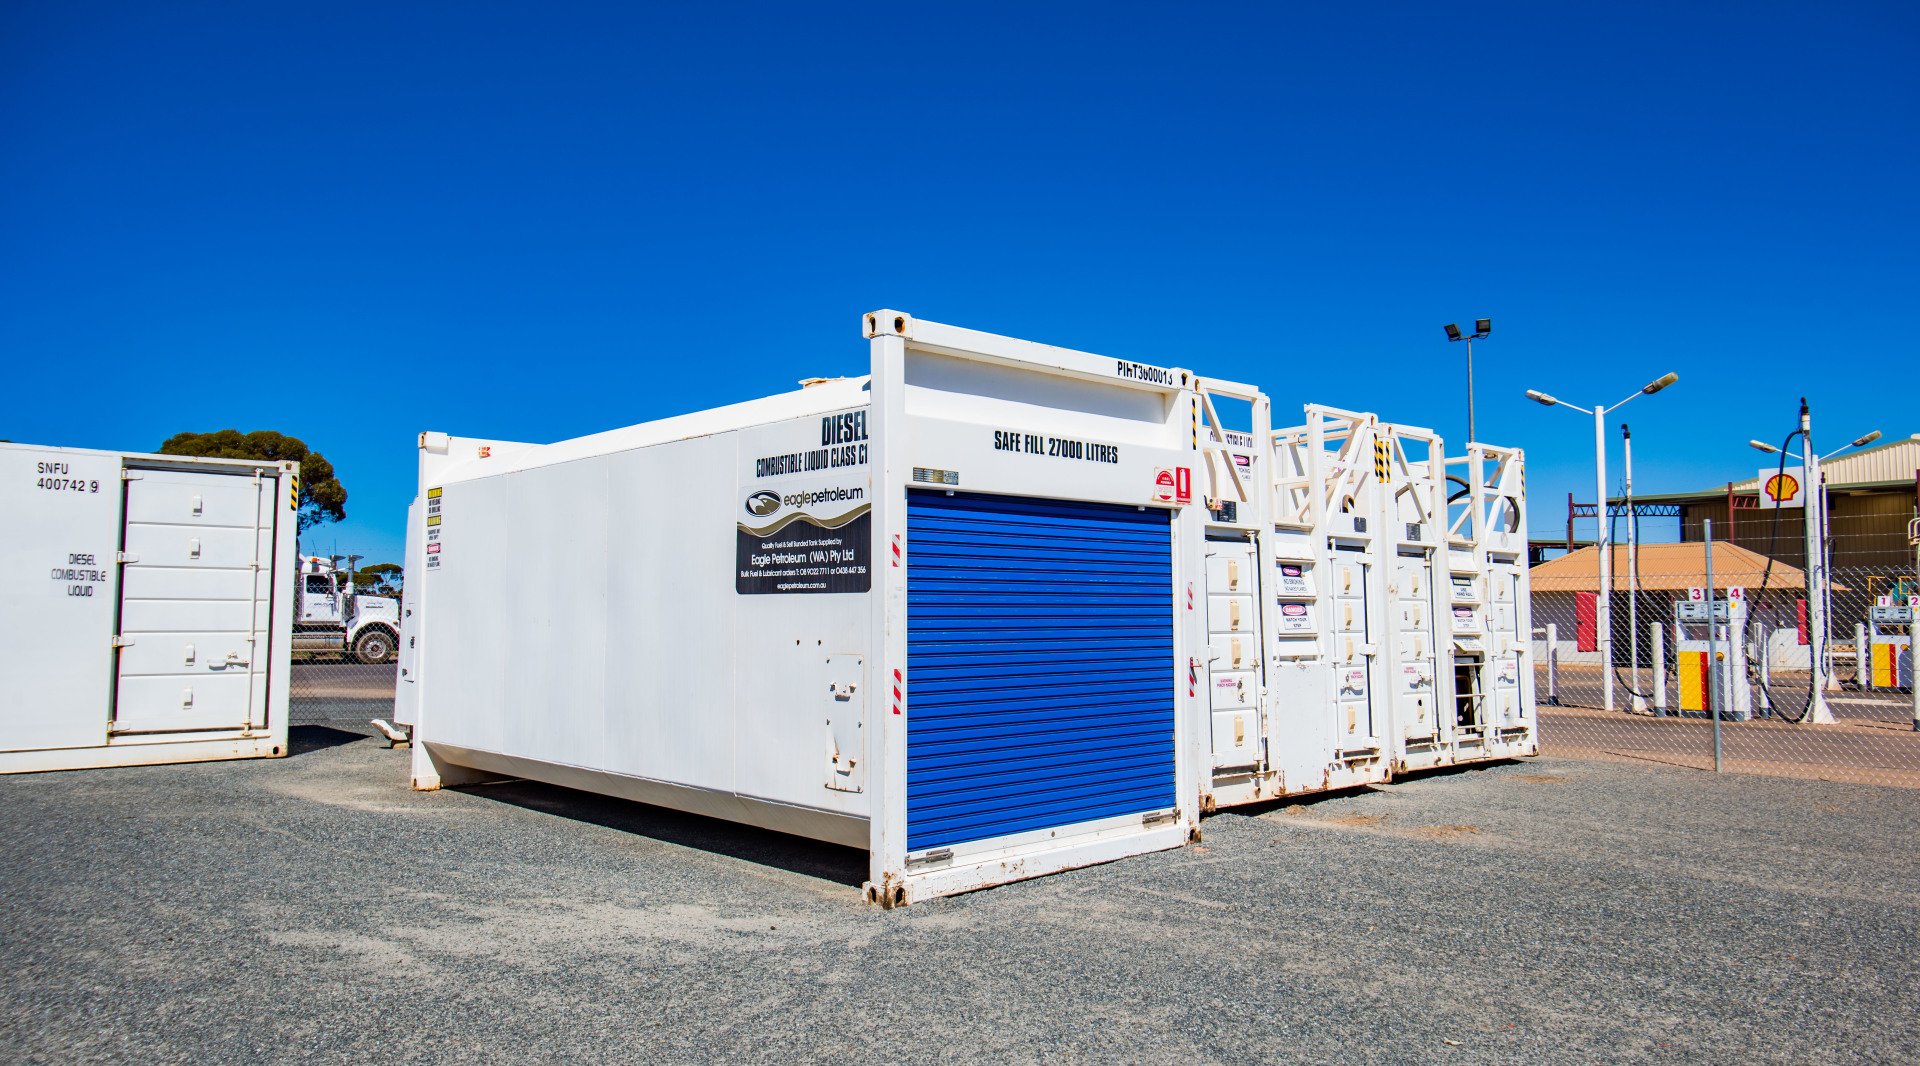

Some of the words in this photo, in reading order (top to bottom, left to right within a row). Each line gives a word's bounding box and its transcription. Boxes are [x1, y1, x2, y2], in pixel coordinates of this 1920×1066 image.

[821, 410, 868, 446] DIESEL
[994, 430, 1021, 453] SAFE
[1024, 434, 1045, 455] FILL
[1048, 437, 1082, 460] 27000
[1085, 442, 1118, 464] LITRES
[756, 452, 802, 478] COMBUSTIBLE
[804, 448, 829, 471] LIQUID
[831, 445, 857, 468] CLASS
[858, 443, 868, 465] C1
[37, 462, 69, 475] SNFU
[37, 478, 86, 492] 400742
[90, 480, 98, 493] 9
[783, 487, 864, 508] eaglepetroleum
[68, 553, 96, 565] DIESEL
[751, 553, 770, 567] Eagle
[771, 552, 807, 565] Petroleum
[810, 550, 829, 564] (WA)
[830, 550, 842, 564] Pty
[842, 549, 854, 561] Ltd
[51, 568, 107, 582] COMBUSTIBLE
[68, 585, 93, 597] LIQUID
[1692, 588, 1702, 600] 3
[1730, 588, 1740, 600] 4
[1881, 597, 1886, 605] 1
[1911, 596, 1919, 606] 2
